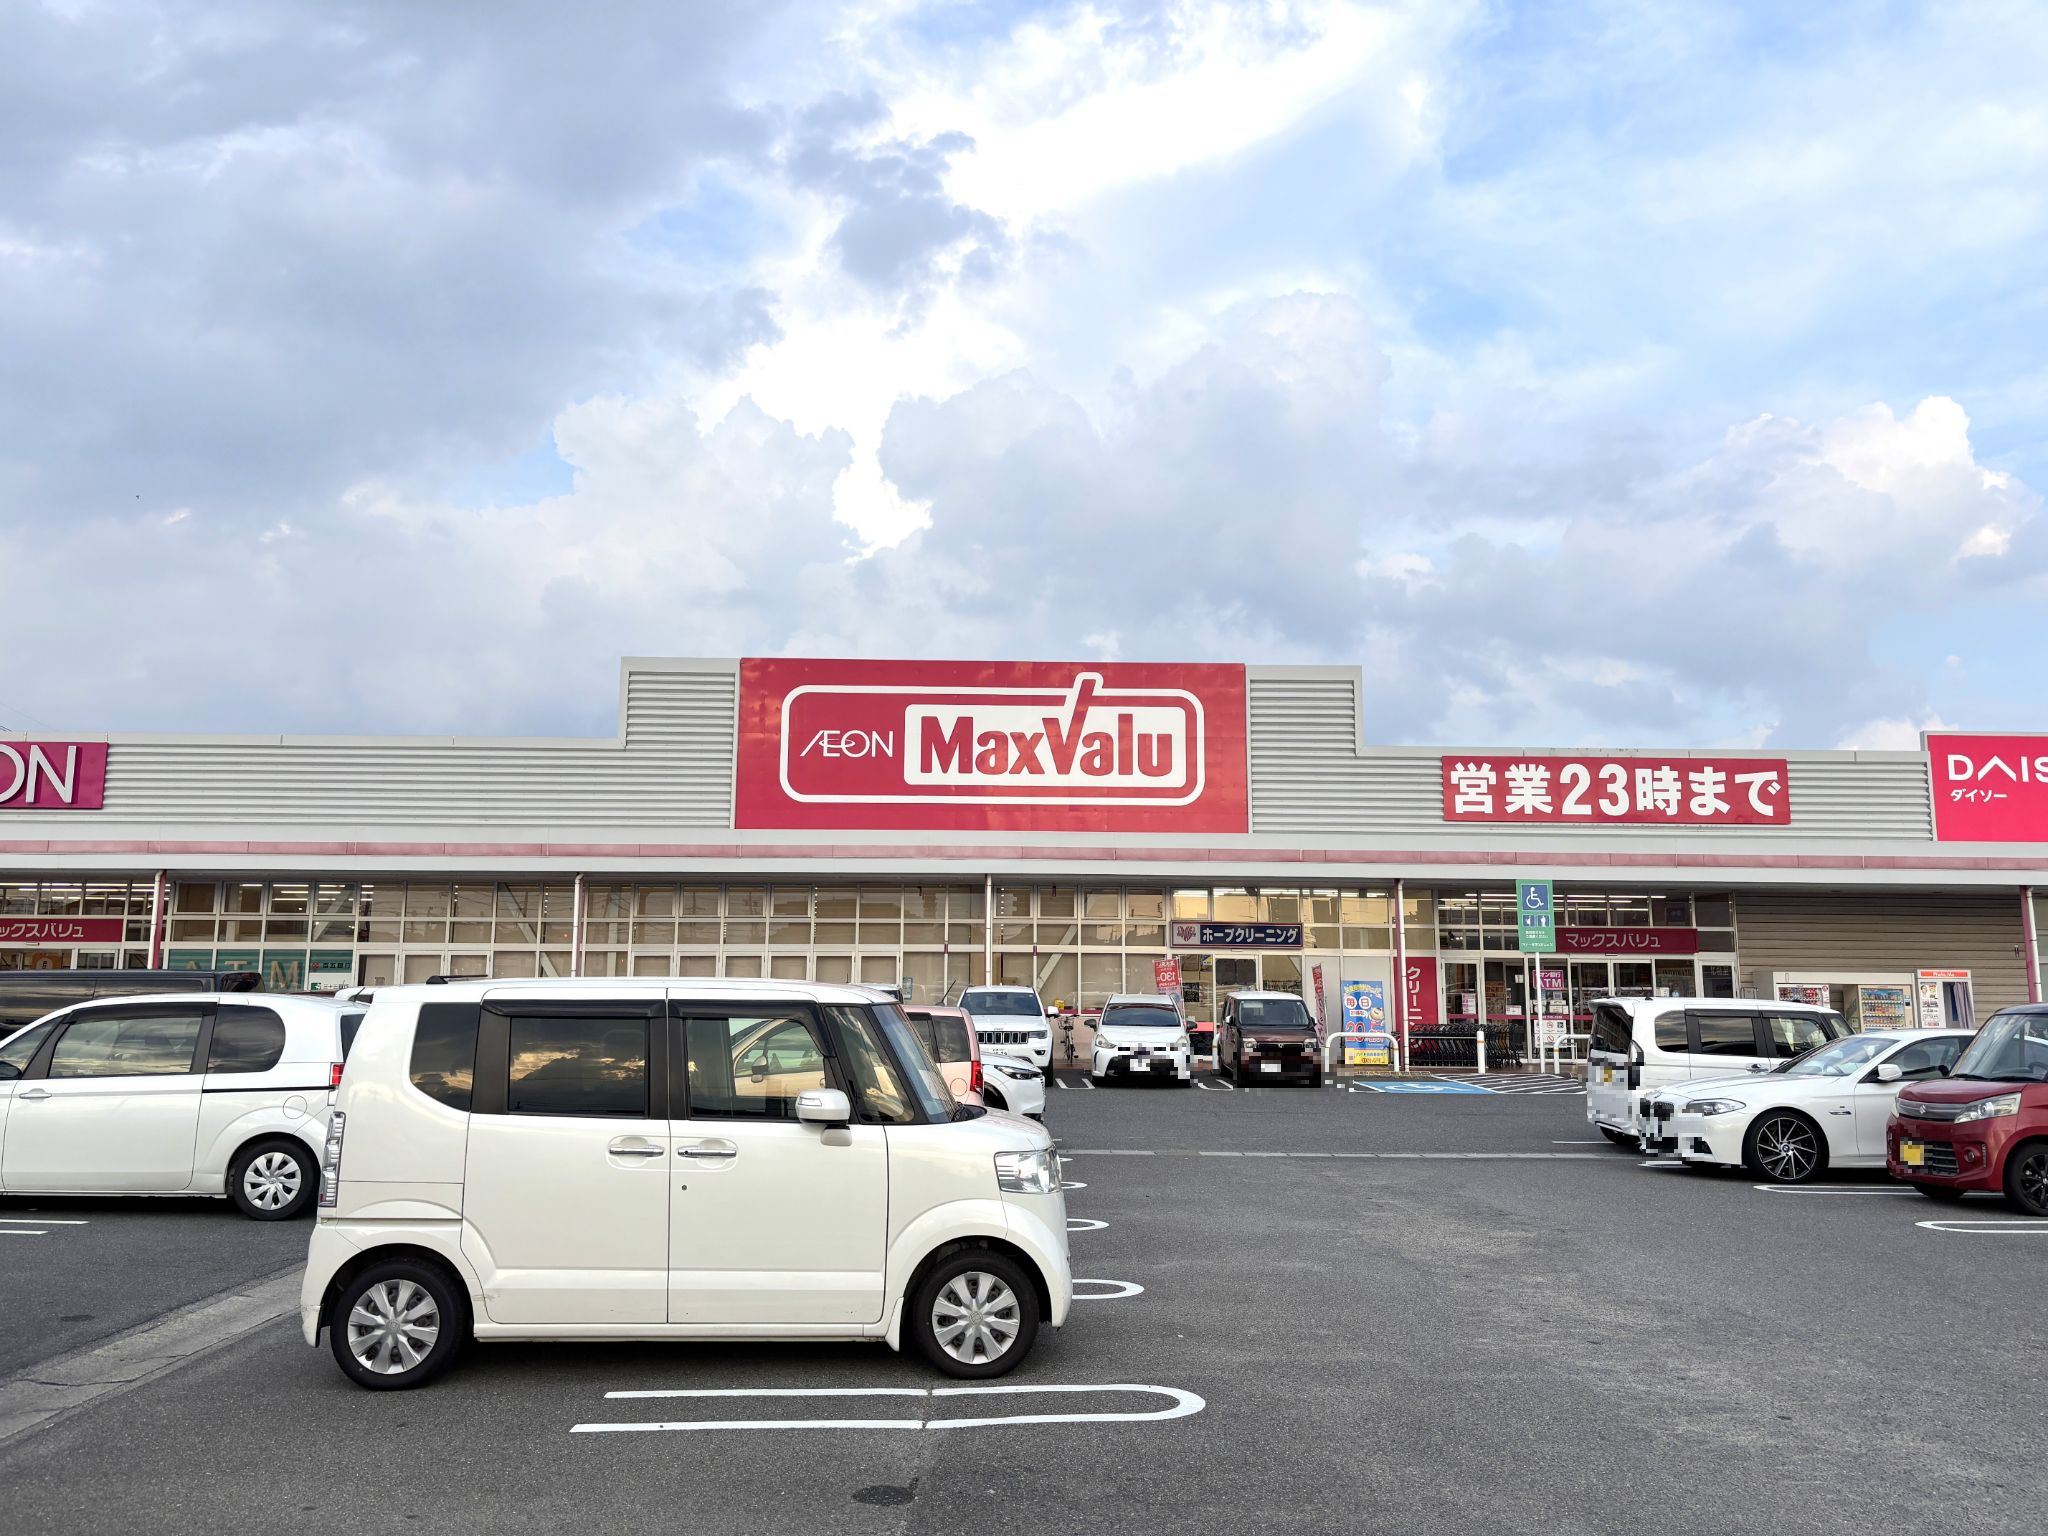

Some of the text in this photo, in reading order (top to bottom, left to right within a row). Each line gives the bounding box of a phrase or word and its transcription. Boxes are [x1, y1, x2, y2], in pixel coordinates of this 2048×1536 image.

[920, 679, 1173, 777] MaxValu
[1450, 762, 1782, 817] 営業23時まで
[1950, 788, 2008, 803] ダイソー
[1202, 927, 1299, 943] ホープクリーニング
[1565, 933, 1662, 948] マックスバリュ
